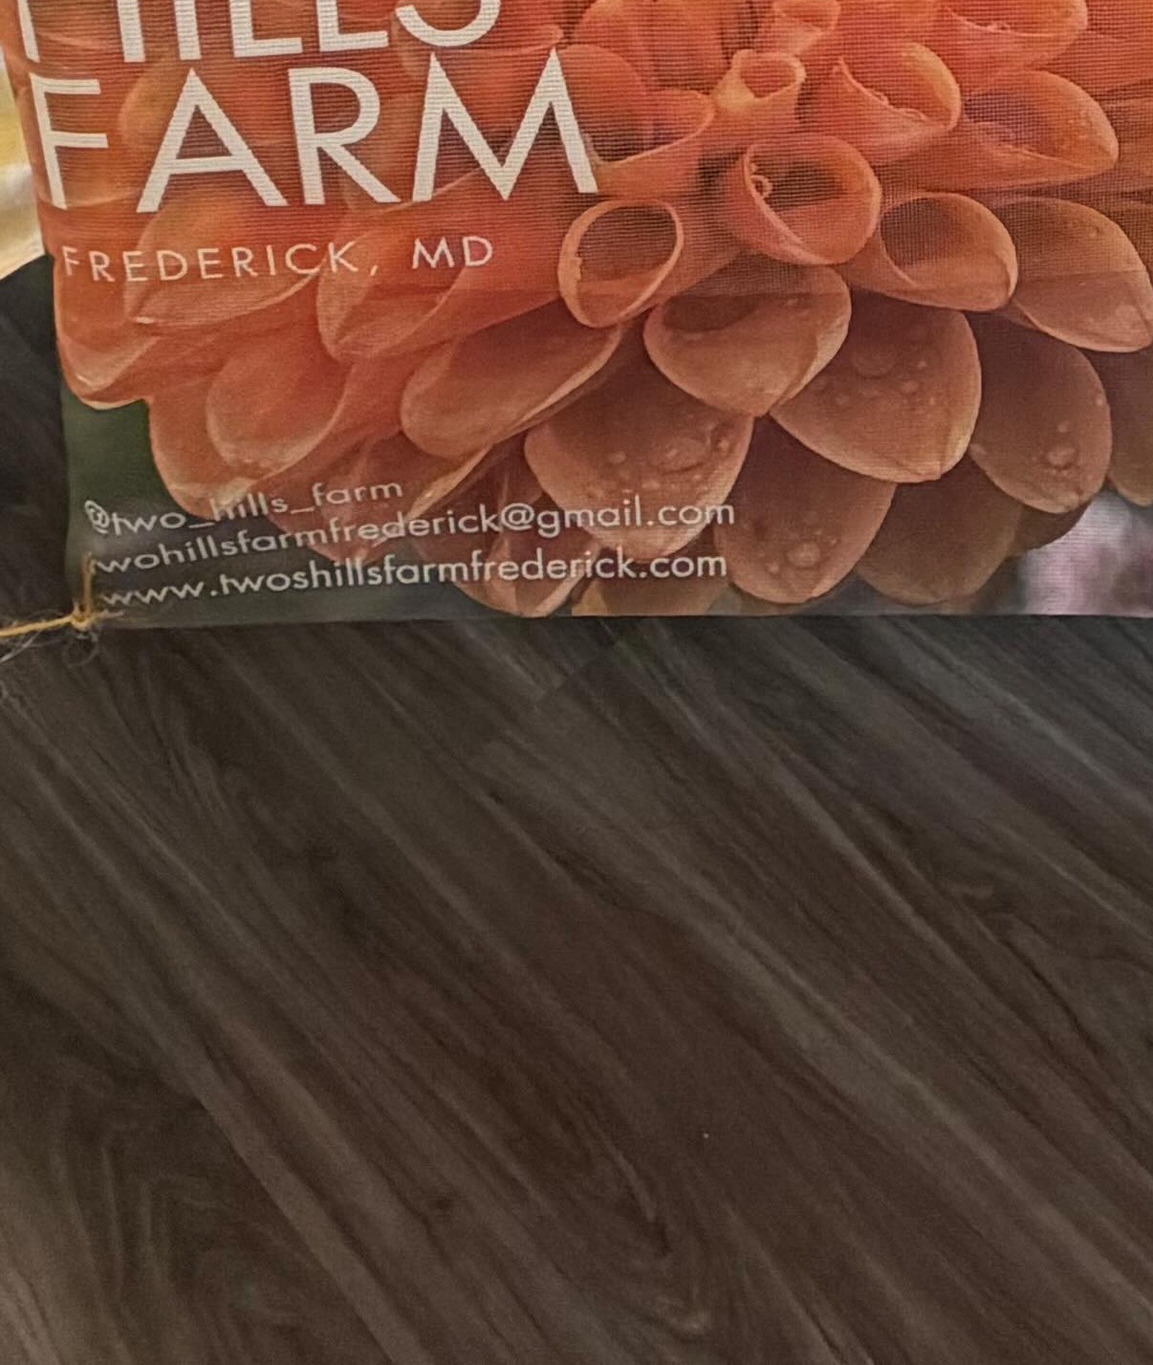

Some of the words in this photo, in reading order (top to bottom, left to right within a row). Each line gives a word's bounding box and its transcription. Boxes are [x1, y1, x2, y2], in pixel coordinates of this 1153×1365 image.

[28, 47, 599, 214] FARM
[61, 241, 380, 285] FREDERICK,
[411, 235, 495, 270] MD
[84, 478, 403, 535] @two_hills_farm
[101, 545, 729, 609] www.twoshillsfarmfrederick.com
